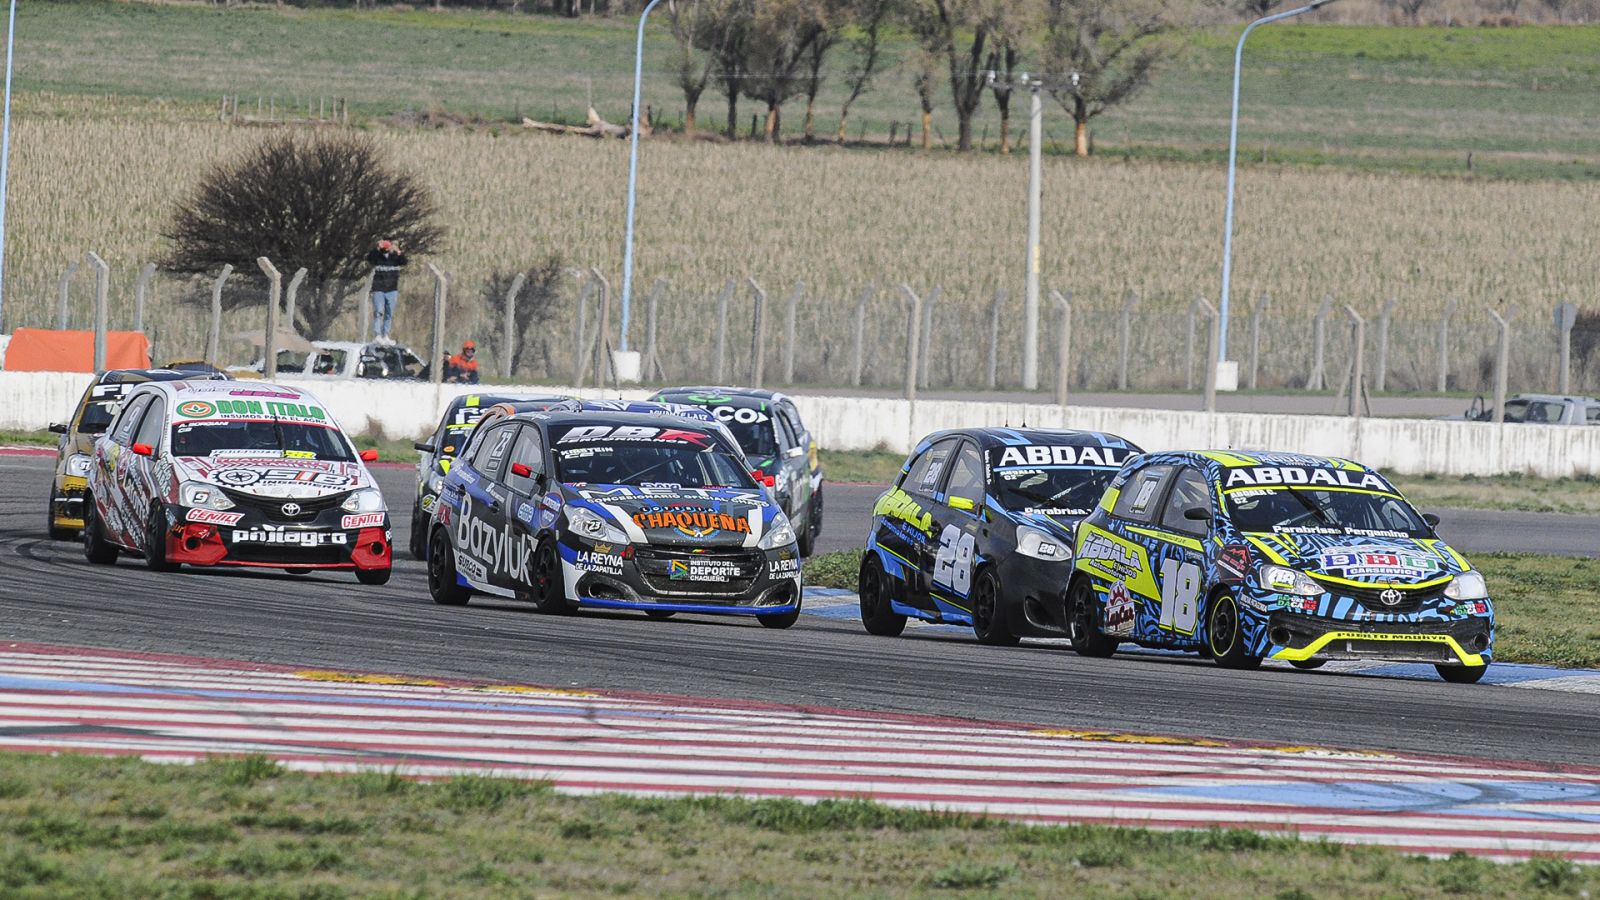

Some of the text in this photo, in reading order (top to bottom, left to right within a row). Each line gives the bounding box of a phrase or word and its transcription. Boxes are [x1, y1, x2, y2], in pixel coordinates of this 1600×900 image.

[216, 401, 326, 419] DON ITALO
[1226, 467, 1388, 492] ABDALA
[193, 491, 209, 504] 9
[187, 510, 243, 524] GENTILI
[343, 514, 384, 528] GENTILI
[632, 511, 752, 534] CHAQUEÑA
[588, 521, 600, 530] 23
[1272, 525, 1409, 538] Parabrisas Pergamino
[457, 493, 538, 587] Bazyluk
[1038, 543, 1055, 555] 28
[577, 551, 623, 567] LA REYNA
[769, 560, 780, 572] LA
[932, 523, 976, 599] 28
[575, 562, 623, 575] DE LA ZAPATILLA
[690, 566, 740, 576] DEPORTE
[1350, 568, 1420, 576] CARSERVICE
[1159, 558, 1200, 632] 18
